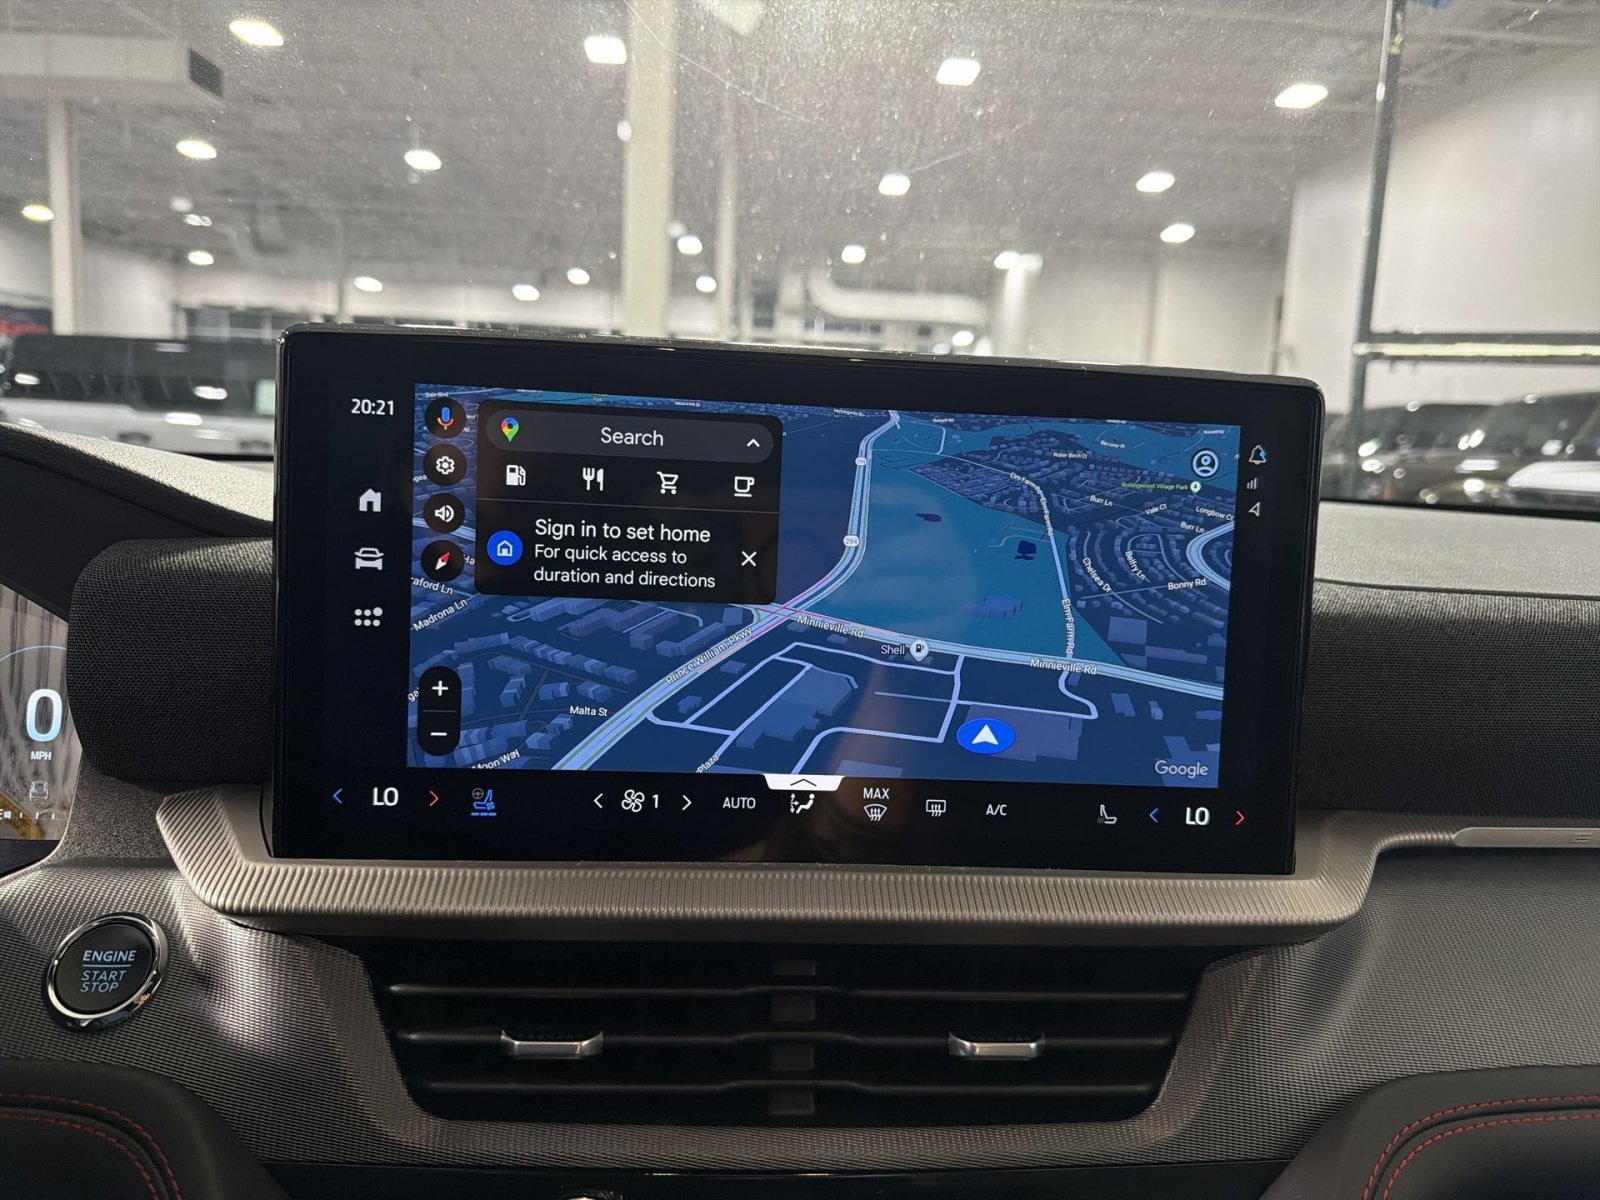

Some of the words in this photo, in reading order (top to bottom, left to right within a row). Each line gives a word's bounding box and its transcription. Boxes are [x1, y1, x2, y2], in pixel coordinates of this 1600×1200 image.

[351, 398, 394, 416] 20:21
[600, 427, 665, 447] Search
[1010, 472, 1021, 481] Elm
[1021, 476, 1036, 489] Farm
[1121, 481, 1155, 489] Rollingwood
[1156, 482, 1174, 490] Village
[1090, 494, 1104, 504] Burr
[1104, 498, 1113, 507] Ln
[1144, 505, 1160, 515] Vale
[1159, 503, 1167, 511] Ct
[1195, 505, 1226, 520] Longbow
[1225, 513, 1234, 521] Ct
[535, 519, 575, 542] Sign
[581, 520, 597, 538] in
[602, 522, 622, 539] to
[626, 522, 656, 541] set
[660, 523, 711, 542] home
[1180, 521, 1196, 531] Burr
[1195, 525, 1205, 533] Ln
[845, 537, 858, 545] 294
[534, 544, 561, 559] For
[565, 545, 608, 566] quick
[612, 550, 667, 564] access
[671, 550, 687, 565] to
[1125, 550, 1139, 574] Belfry
[1135, 568, 1146, 581] Ln
[533, 567, 600, 584] duration
[604, 570, 635, 586] and
[638, 571, 716, 589] directions
[1083, 557, 1104, 587] Chelsea
[1102, 582, 1113, 593] Dr
[441, 584, 454, 595] Ln
[1168, 581, 1194, 591] Bonny
[1195, 578, 1207, 587] Rd
[412, 606, 455, 632] Madrona
[454, 599, 468, 611] Ln
[1062, 598, 1072, 617] Elm
[797, 615, 849, 635] Minnieville
[850, 624, 865, 638] Rd
[1066, 617, 1075, 640] Farm
[665, 665, 695, 686] Prince
[694, 642, 727, 667] William
[727, 627, 753, 646] Pkwy
[881, 644, 905, 655] Shell
[1066, 642, 1075, 655] Rd
[1030, 658, 1081, 673] Minnieville
[1084, 665, 1097, 675] Rd
[26, 688, 63, 743] 0
[569, 705, 597, 715] Malta
[598, 707, 608, 717] St
[31, 751, 52, 761] MPH
[500, 748, 520, 764] Way
[697, 754, 719, 774] Plaza
[1154, 759, 1208, 778] Google
[372, 787, 399, 806] LO
[652, 794, 659, 808] 1
[863, 788, 889, 799] MAX
[723, 797, 756, 810] AUTO
[985, 804, 1007, 817] A/C
[1185, 807, 1210, 826] LO
[82, 950, 136, 962] ENGINE
[81, 970, 127, 981] START
[80, 982, 119, 993] STOP
